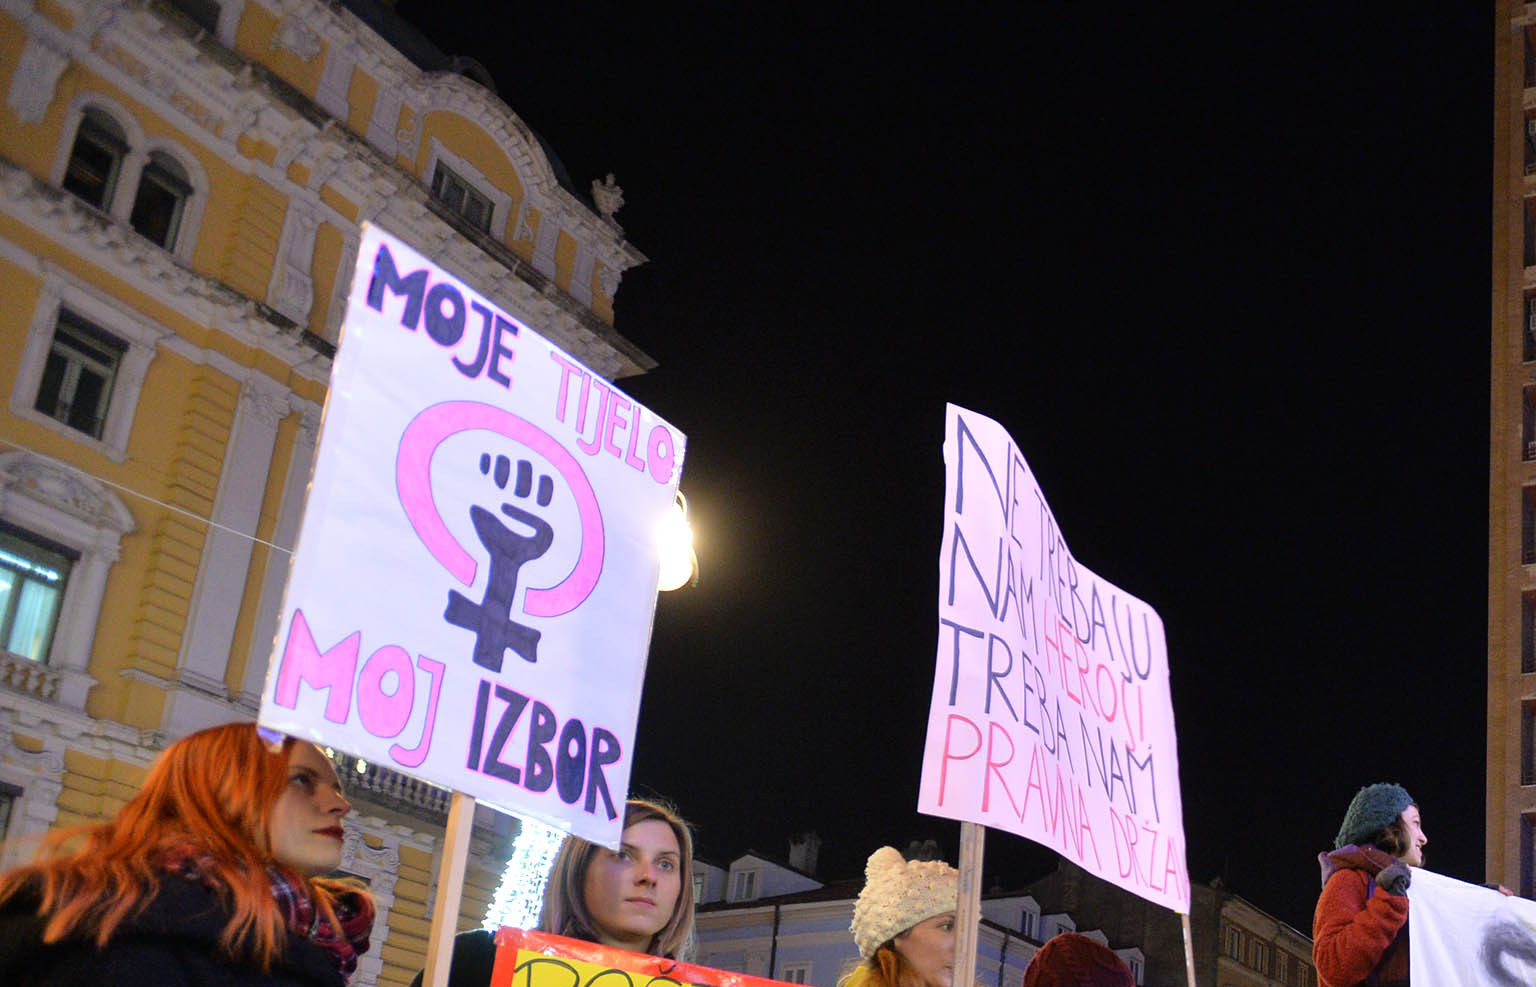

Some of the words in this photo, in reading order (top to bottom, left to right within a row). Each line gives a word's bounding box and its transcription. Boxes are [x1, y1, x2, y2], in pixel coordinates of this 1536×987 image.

[366, 242, 518, 389] MOJE
[551, 351, 675, 484] TIJELO
[948, 521, 1039, 655] NAM
[955, 414, 1025, 549] NE
[1034, 488, 1151, 683] TREBAJU
[276, 609, 446, 767] MOJ
[466, 677, 623, 821] IZBOR
[938, 713, 1101, 871] PRAVNA
[940, 617, 1074, 775] TREBA
[1079, 711, 1160, 824] NAM
